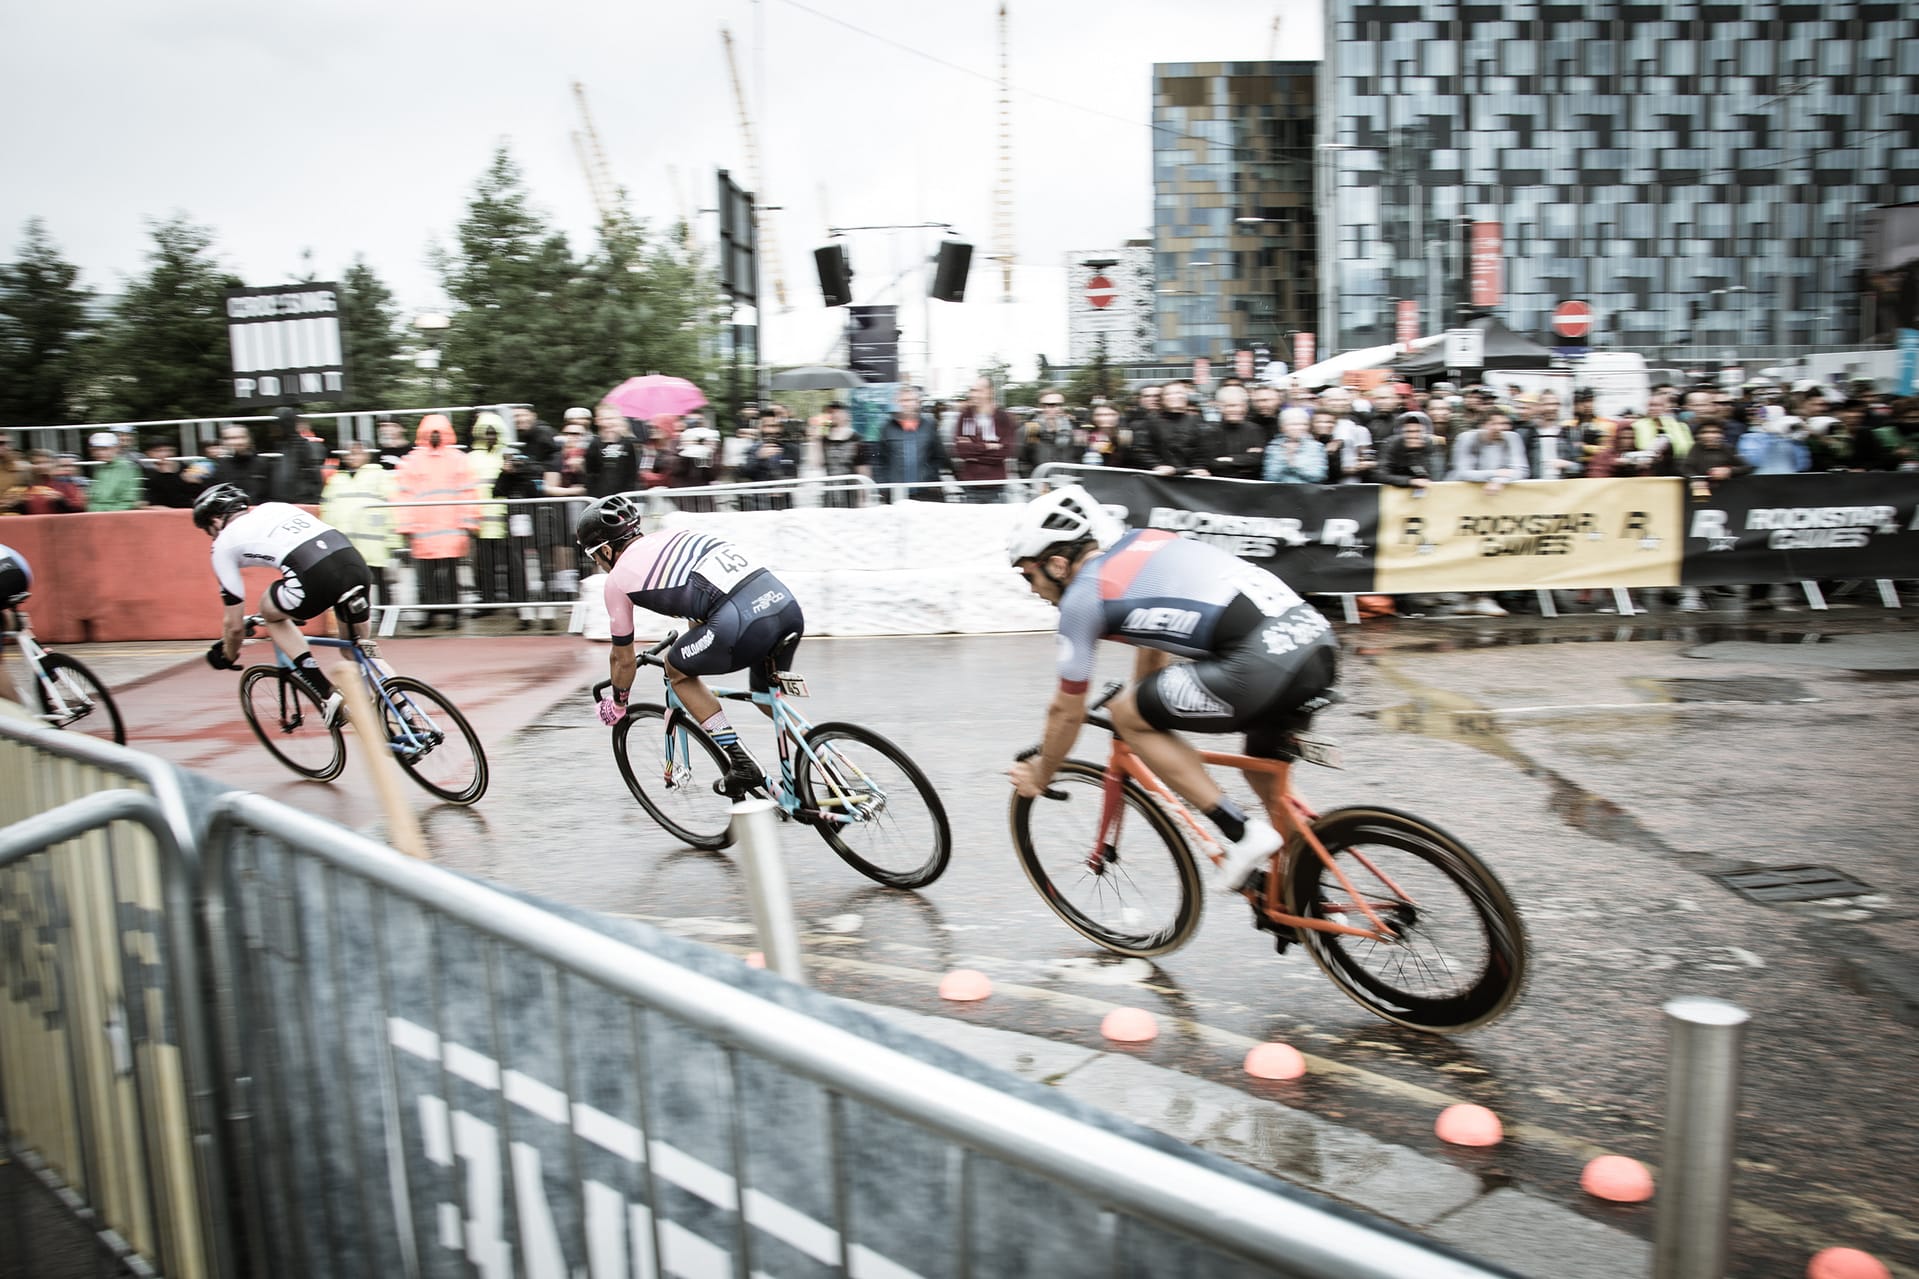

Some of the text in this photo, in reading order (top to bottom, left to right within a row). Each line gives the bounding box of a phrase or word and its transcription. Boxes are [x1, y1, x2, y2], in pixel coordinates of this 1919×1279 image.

[282, 518, 311, 534] 58
[1457, 513, 1597, 536] ROCKSTAR
[1746, 506, 1898, 530] ROCKSTAR
[1480, 535, 1572, 557] GAMES
[1767, 527, 1871, 550] GAMES
[714, 548, 748, 573] 45
[787, 681, 801, 697] 45
